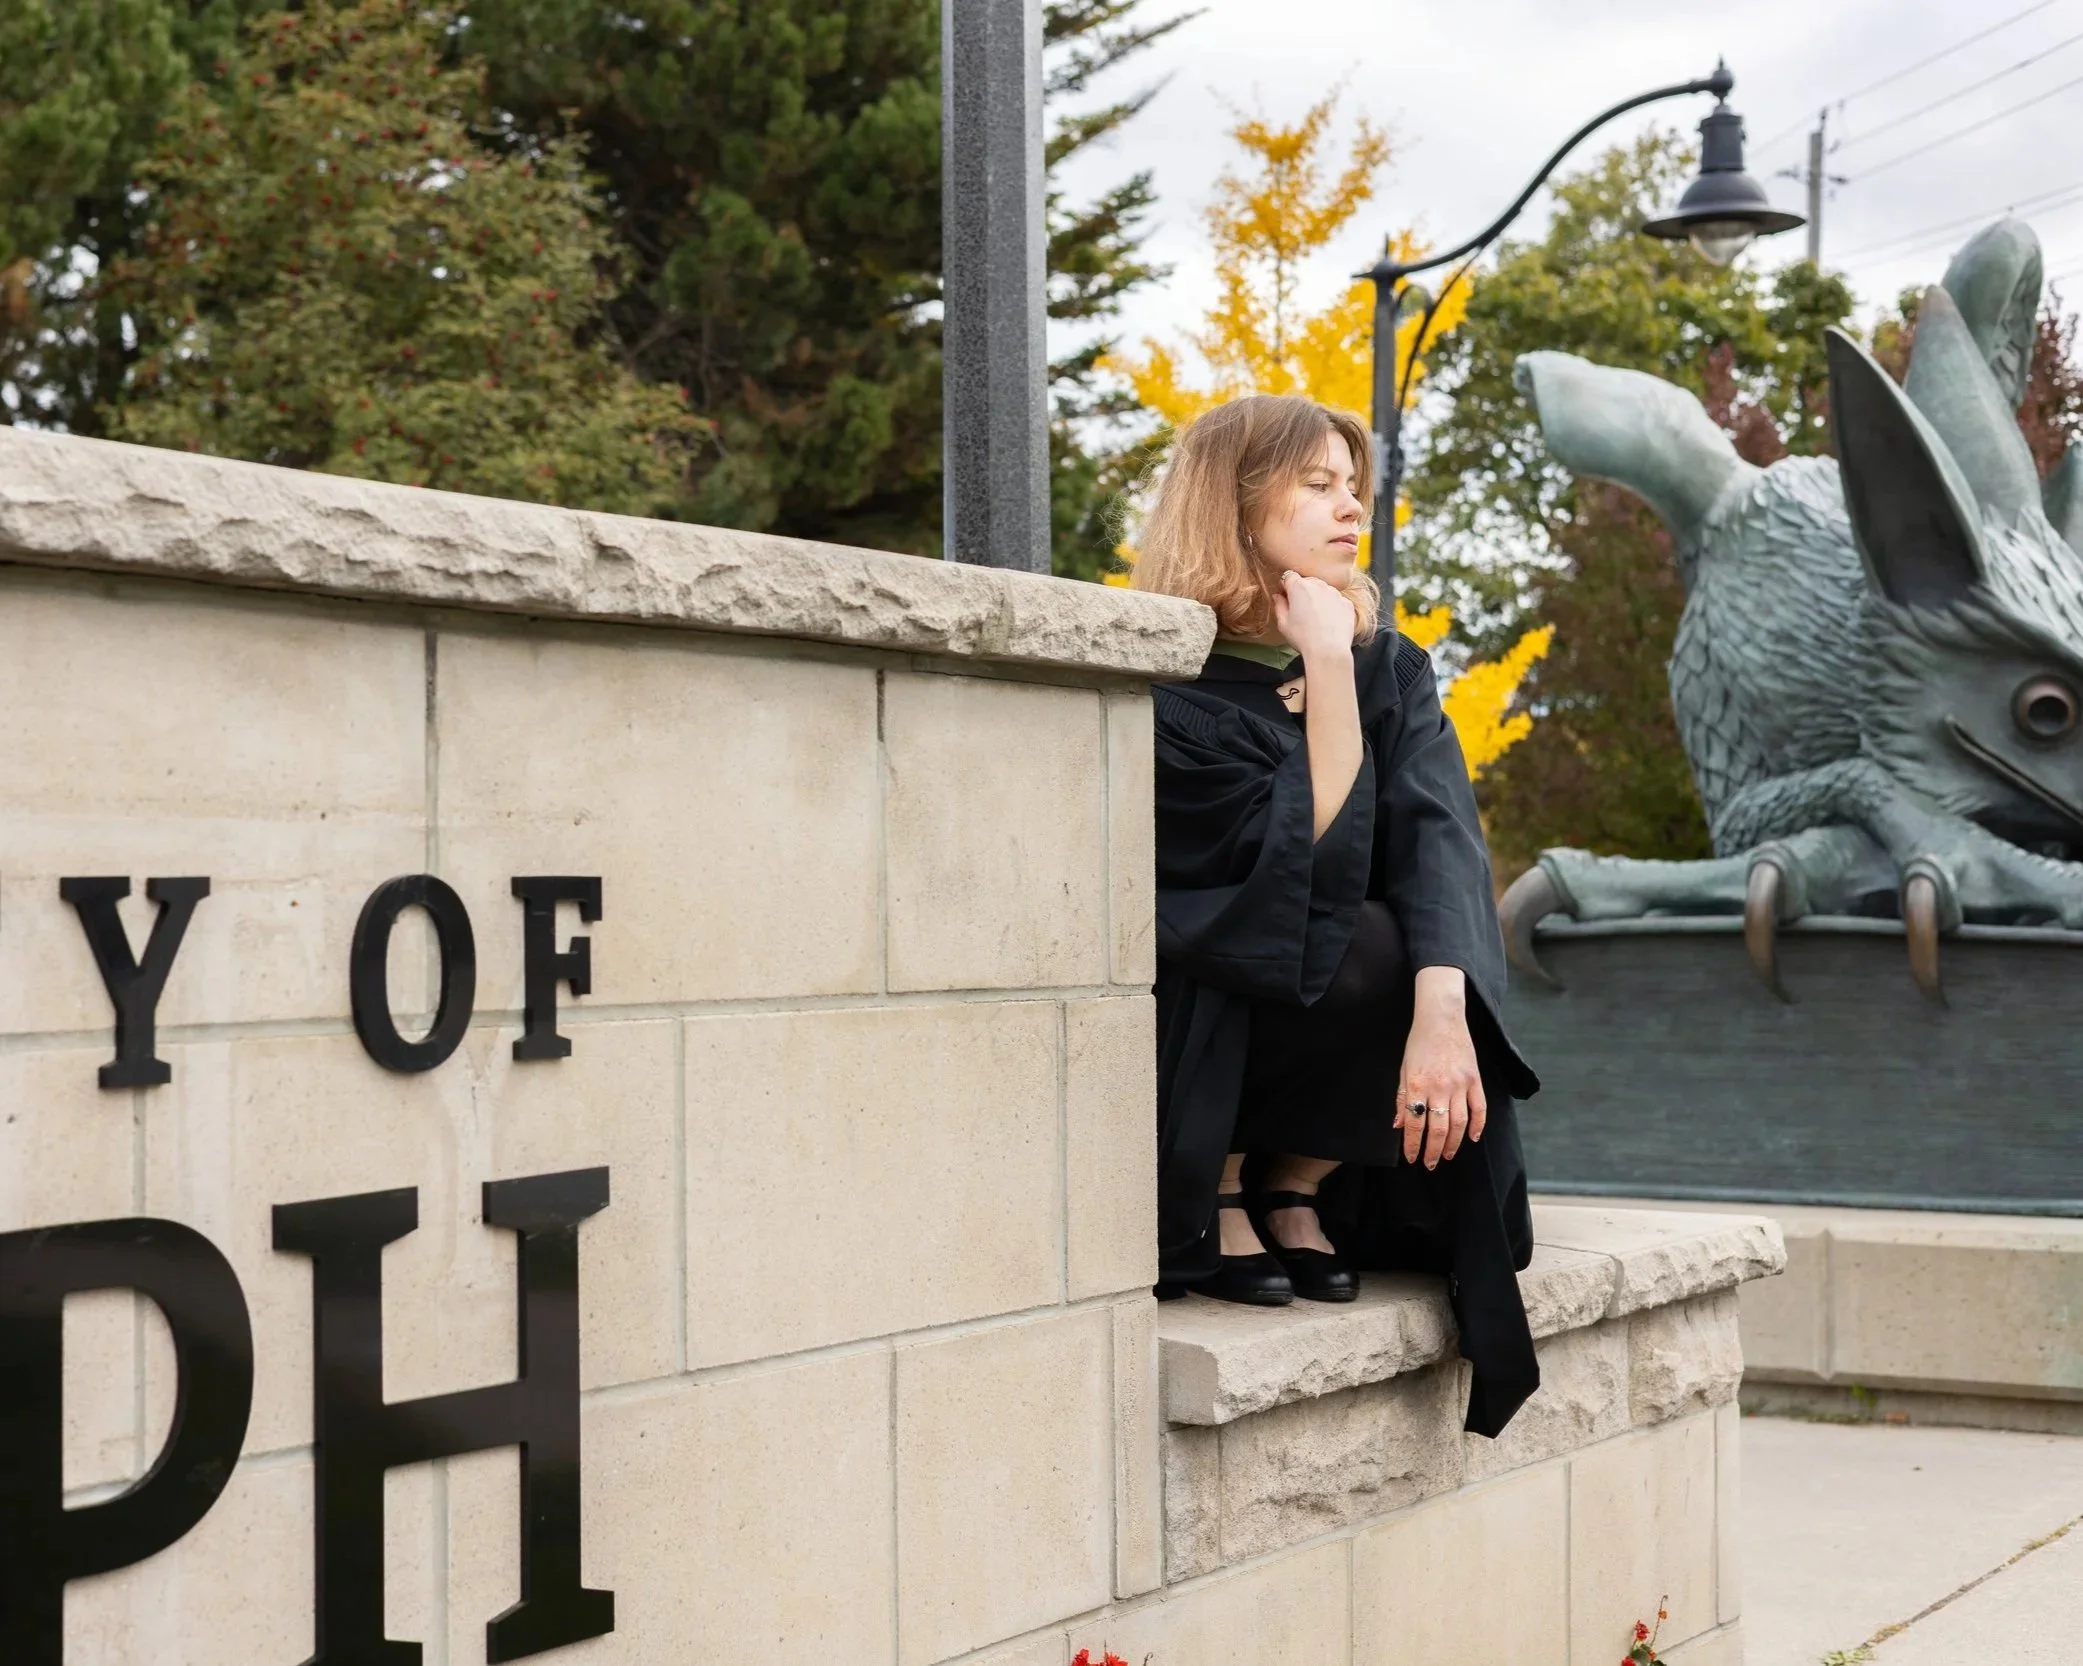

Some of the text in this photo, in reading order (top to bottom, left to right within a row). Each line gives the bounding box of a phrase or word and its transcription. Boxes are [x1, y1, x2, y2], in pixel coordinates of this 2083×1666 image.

[60, 874, 603, 1091] Y OF
[0, 1166, 615, 1666] PH
